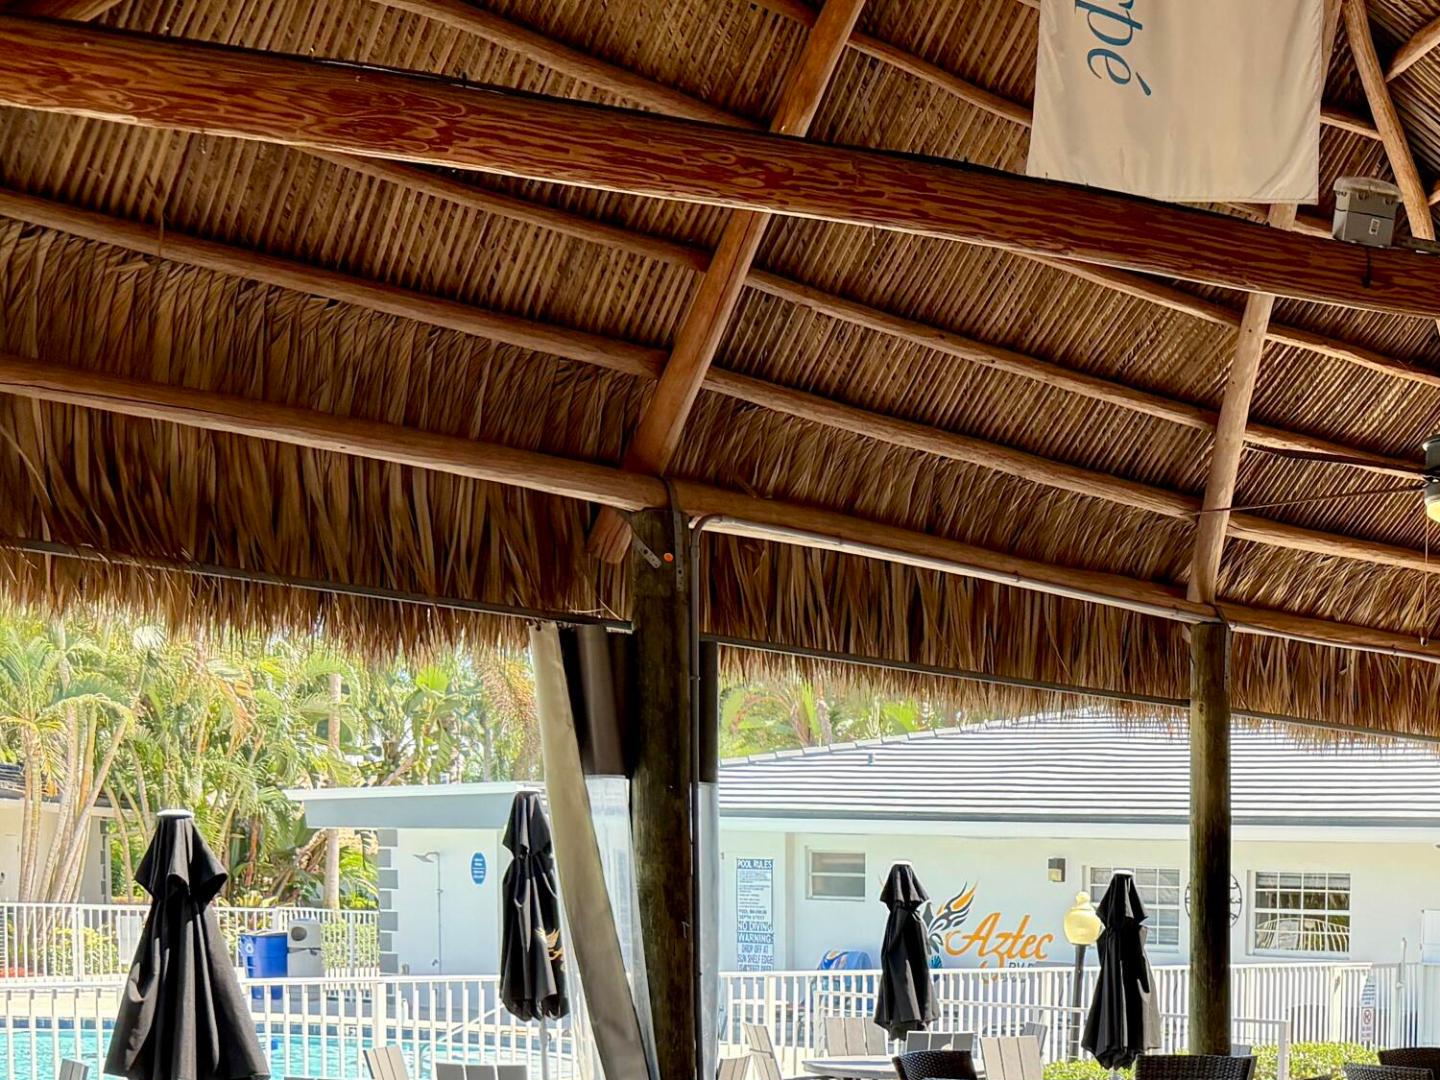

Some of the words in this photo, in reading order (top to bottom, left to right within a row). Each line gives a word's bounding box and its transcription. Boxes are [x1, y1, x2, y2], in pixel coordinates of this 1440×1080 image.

[737, 860, 753, 869] POOL
[754, 860, 772, 869] RULES
[738, 921, 748, 931] NO
[749, 921, 773, 932] DIVING
[945, 912, 1055, 968] Aztec
[742, 944, 753, 953] DROP
[754, 944, 762, 954] OFF
